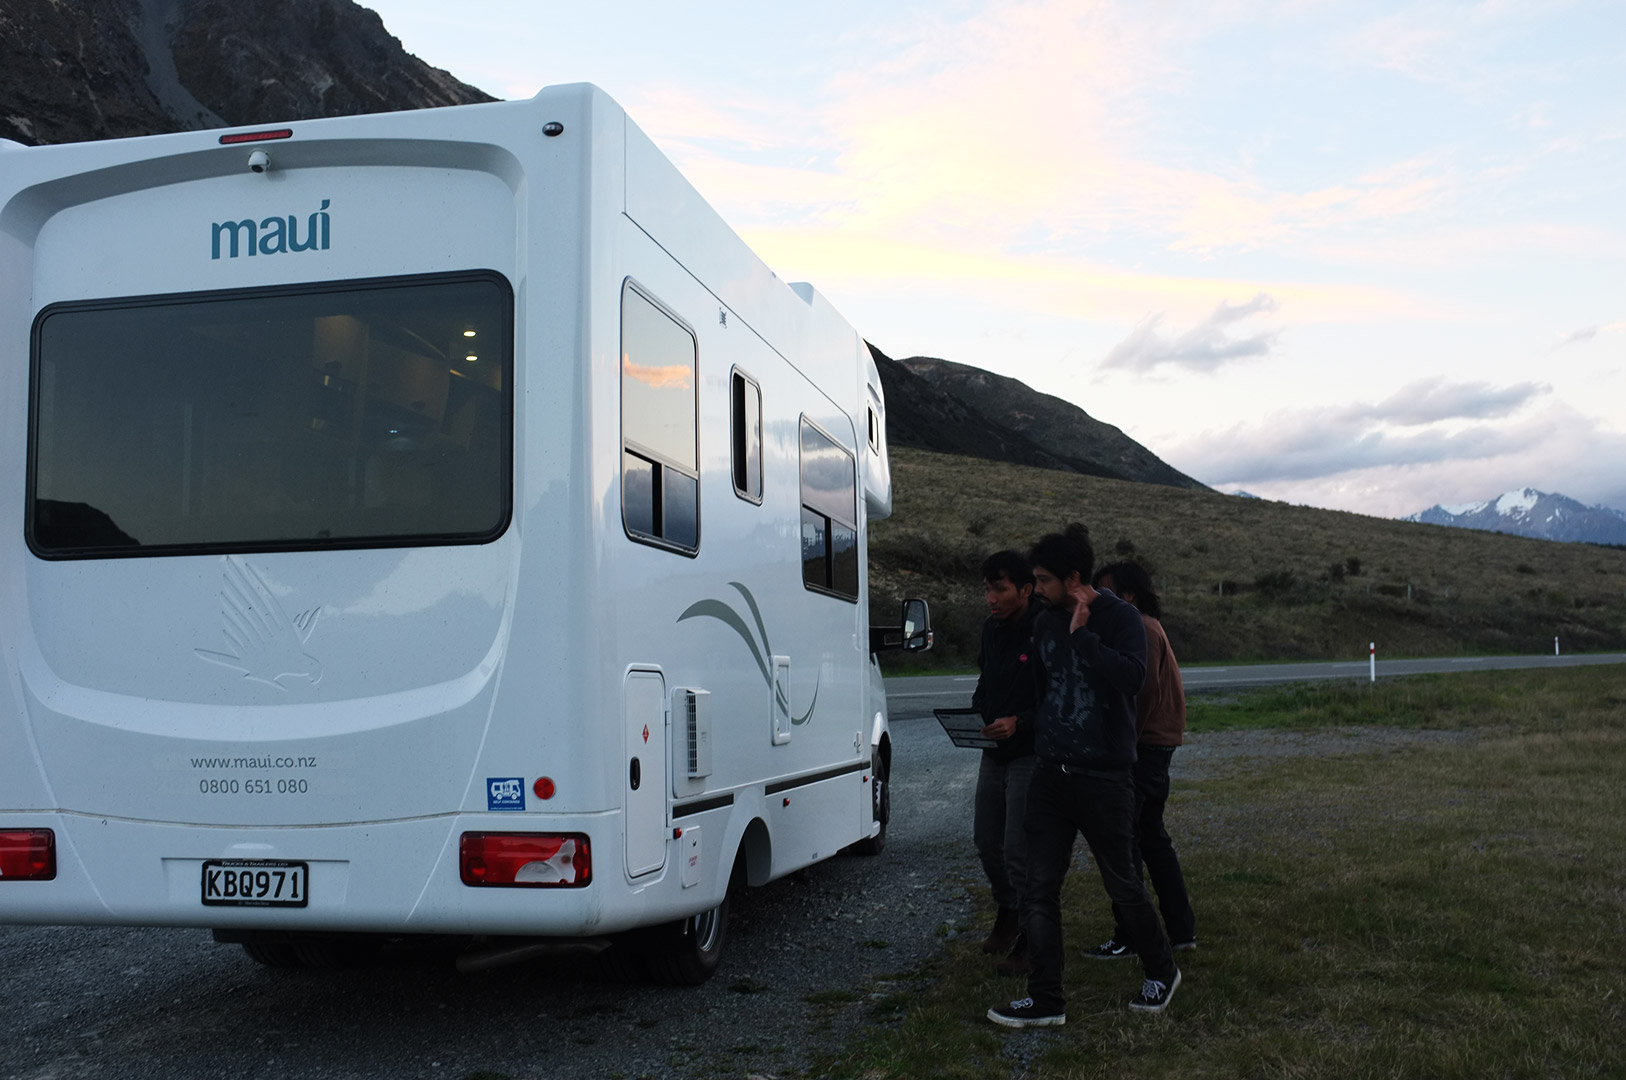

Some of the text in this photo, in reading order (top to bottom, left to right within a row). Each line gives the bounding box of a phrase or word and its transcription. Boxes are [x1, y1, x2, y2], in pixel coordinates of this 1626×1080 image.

[190, 754, 317, 769] www.maui.co.nz
[199, 779, 308, 794] 0800 651 080
[207, 870, 299, 898] KBQ971
